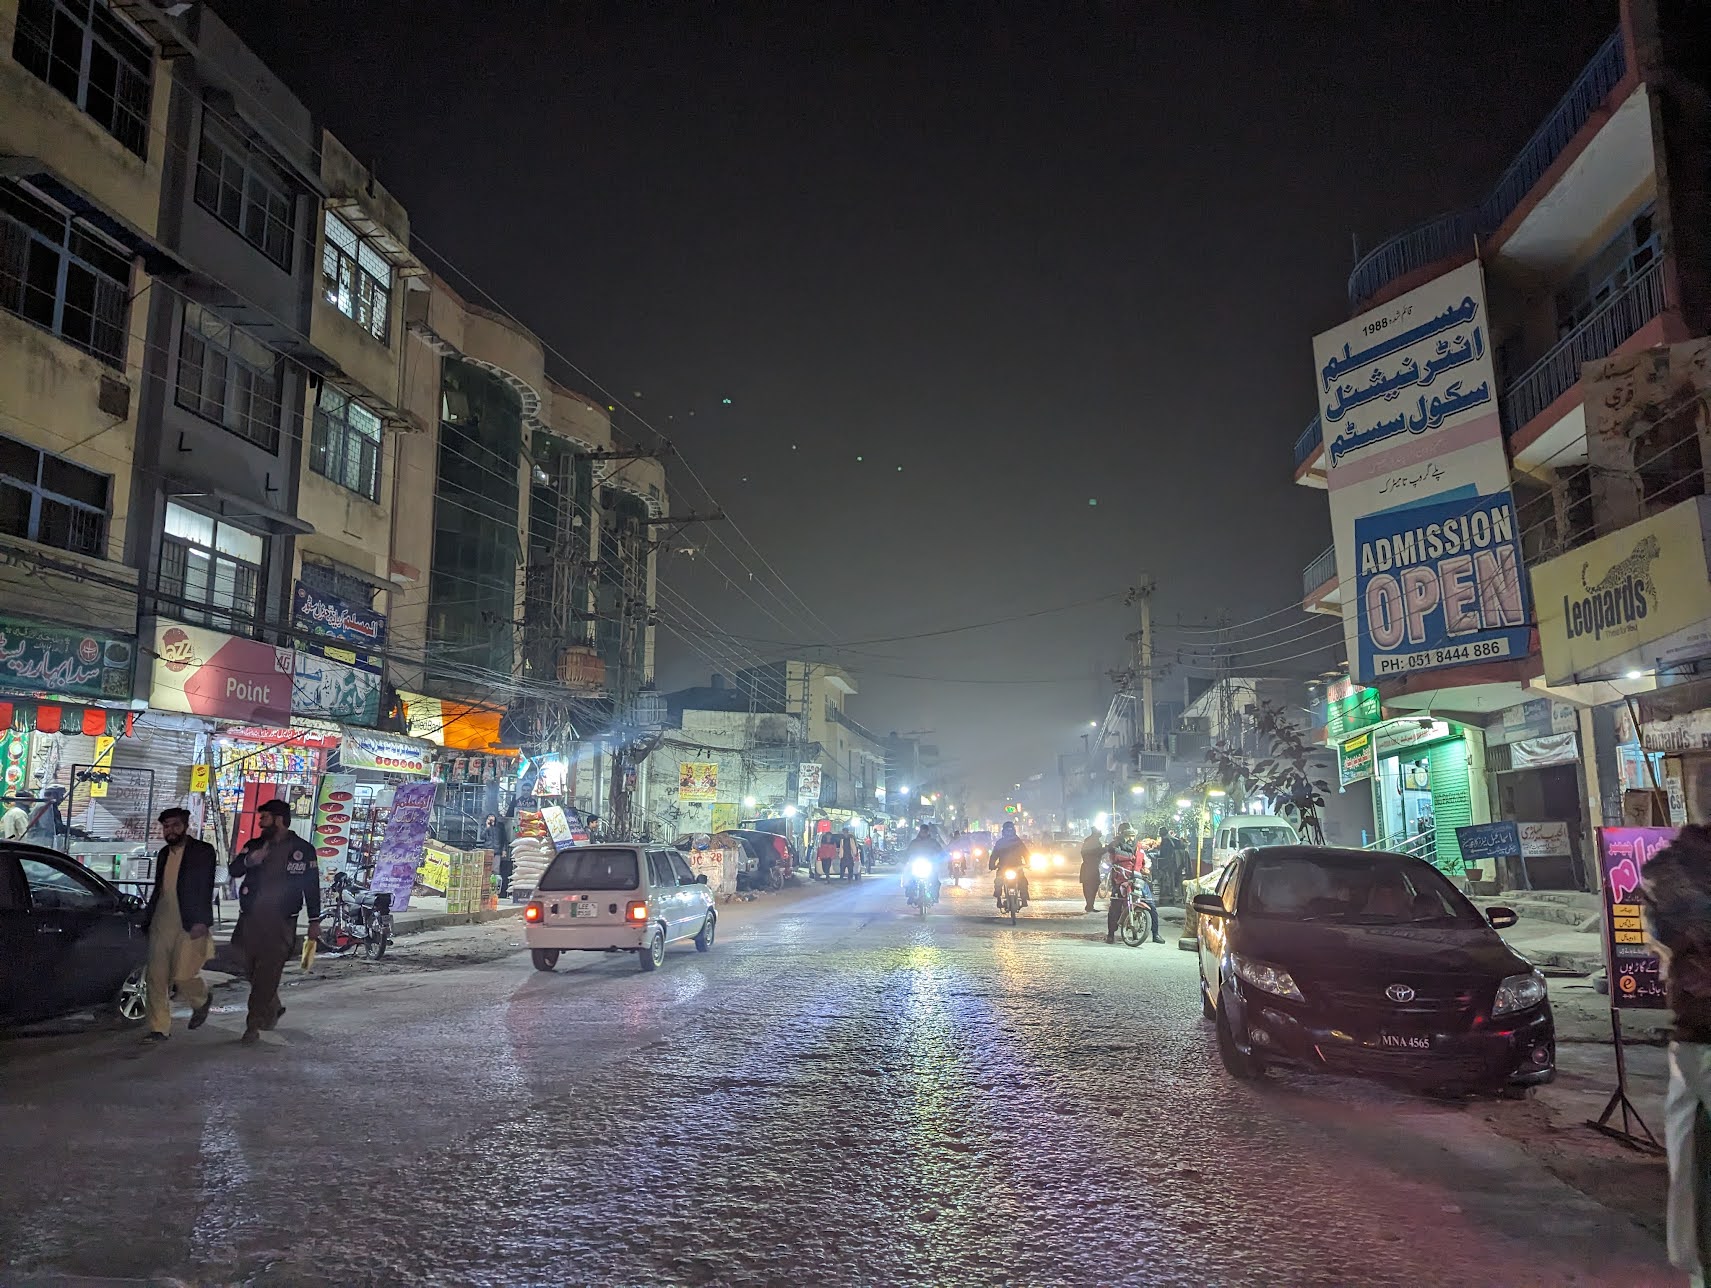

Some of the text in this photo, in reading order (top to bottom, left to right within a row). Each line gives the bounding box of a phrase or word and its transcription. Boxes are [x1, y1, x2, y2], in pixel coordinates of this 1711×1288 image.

[1362, 317, 1388, 336] 1988
[1321, 296, 1478, 391] مسلم
[1324, 326, 1485, 423] انٹرنیشنل
[1408, 380, 1491, 433] سکول
[1330, 411, 1407, 468] سسٹم
[1379, 477, 1401, 494] میٹرک
[1409, 463, 1433, 488] گروپ
[1432, 464, 1445, 481] پلے
[1361, 504, 1513, 576] ADMISSION
[1365, 544, 1524, 650] OPEN
[1563, 575, 1648, 641] Leopards
[1381, 641, 1500, 672] PH: 051 8444 886
[226, 677, 270, 704] Point
[1619, 960, 1645, 975] گاڑیوں
[1382, 1035, 1430, 1049] MNA 4565
